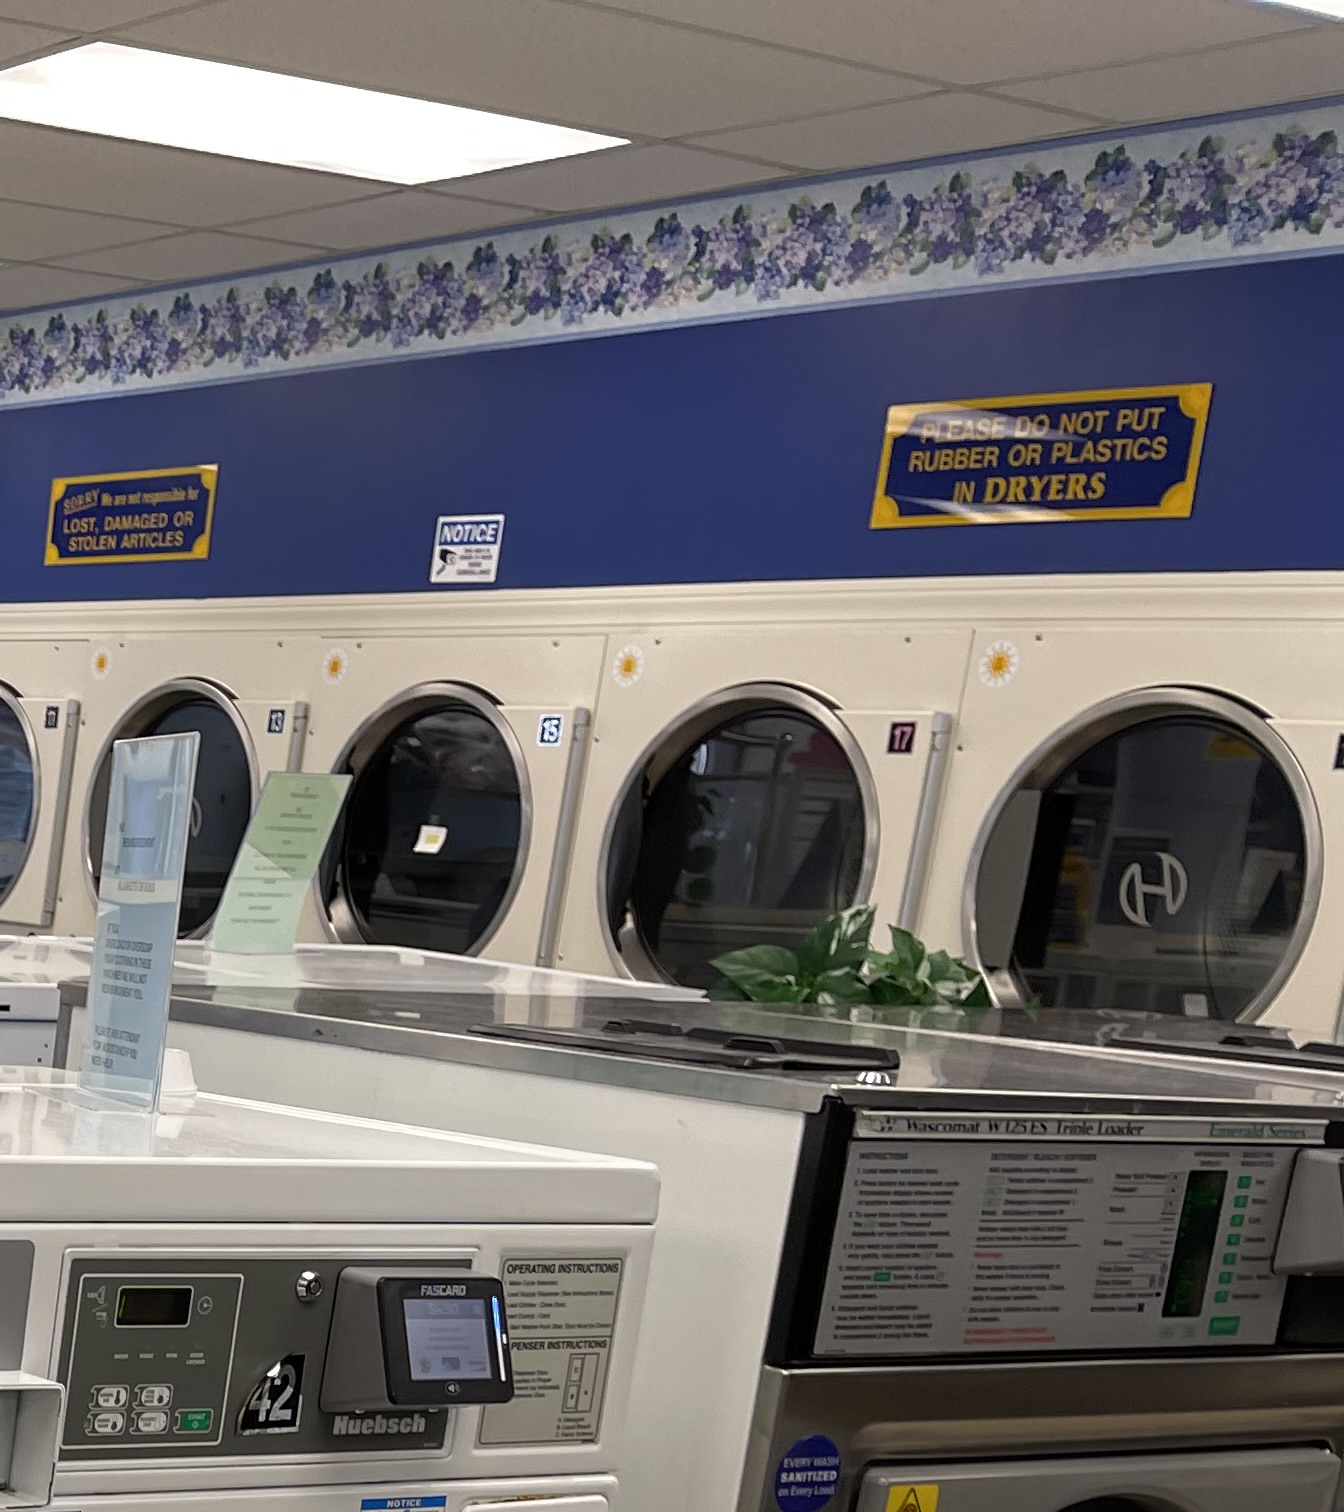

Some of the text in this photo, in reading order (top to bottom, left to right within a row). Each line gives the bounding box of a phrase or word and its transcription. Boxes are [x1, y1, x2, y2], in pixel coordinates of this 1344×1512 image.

[921, 407, 1166, 443] PLEASE DO NOT PUT
[908, 436, 1167, 473] RUBBER OR PLASTICS
[954, 472, 1107, 504] IN DRYERS
[63, 511, 194, 535] LOST, DAMAGED OR
[441, 523, 499, 543] NOTICE
[69, 531, 184, 552] STOLEN ARTICLES
[894, 725, 911, 750] 17
[905, 1119, 1307, 1139] Wascomat Triple Loader Emerald Series
[507, 1263, 619, 1274] OPERATING INSTRUCTIONS
[420, 1285, 467, 1296] FASCARD
[547, 1339, 607, 1350] INSTRUCTIONS
[248, 1363, 296, 1422] 42
[332, 1414, 427, 1436] Huebsch
[780, 1470, 838, 1483] SANITIZED
[386, 1499, 422, 1508] NOTICE
